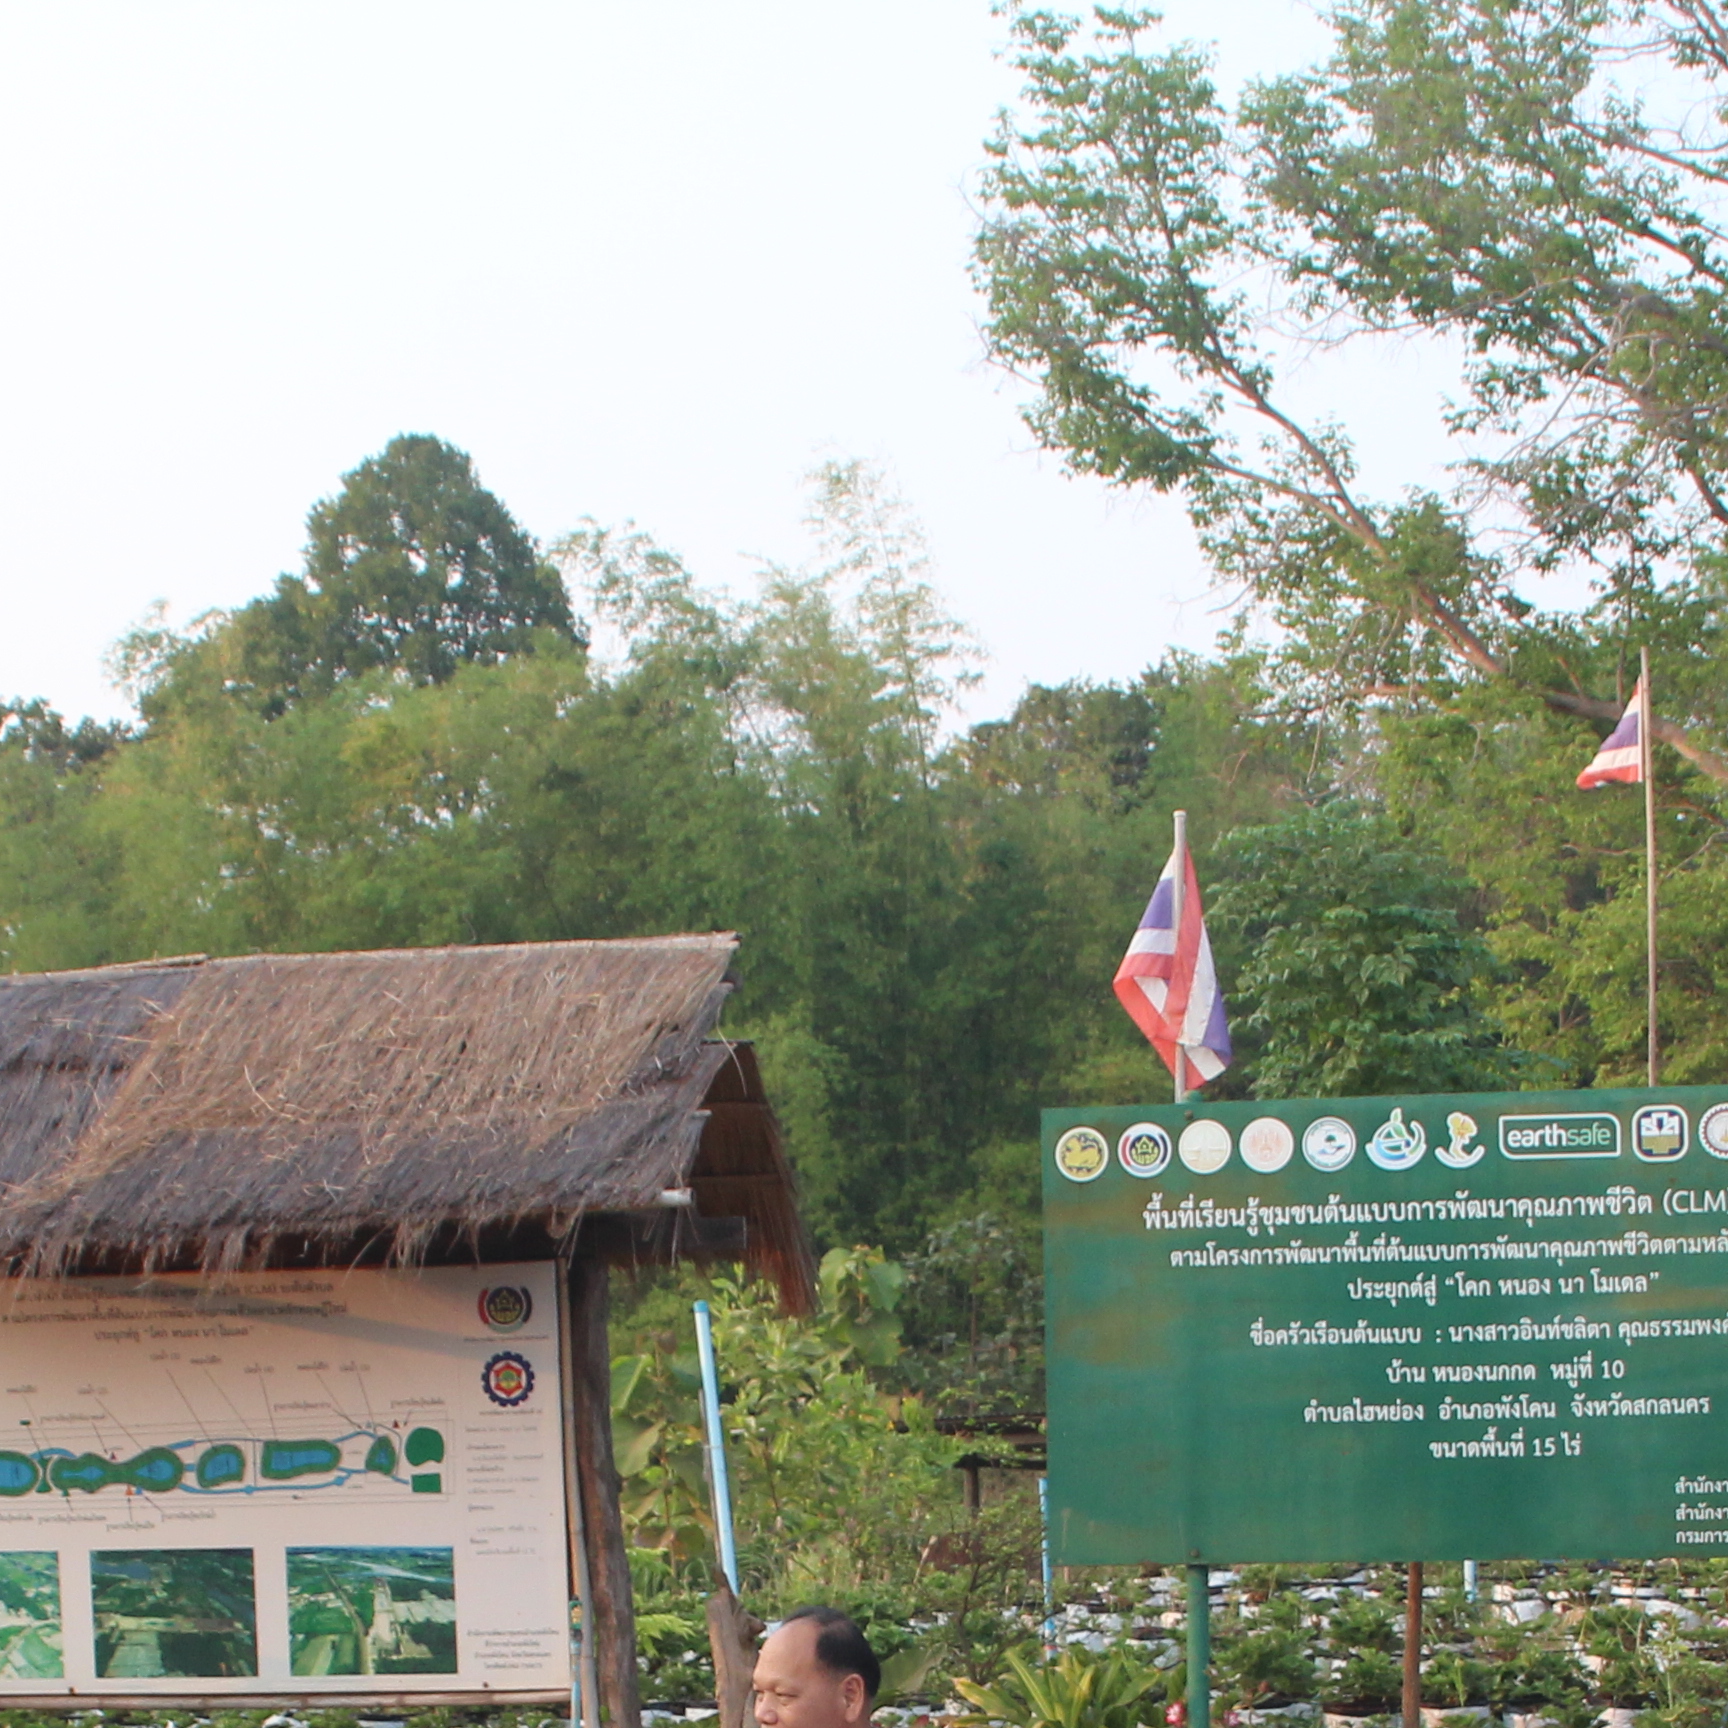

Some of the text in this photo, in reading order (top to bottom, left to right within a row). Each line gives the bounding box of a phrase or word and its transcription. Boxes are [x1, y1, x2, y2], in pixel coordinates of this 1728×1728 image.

[1507, 1121, 1612, 1150] earthsafe
[1142, 1184, 1653, 1237] พื้นที่เรียนรู้ชุมชนต้นแบบการพัฒนาคุณภาพชีวิต
[1347, 1273, 1437, 1307] ประยุกต์สู่
[1498, 1277, 1552, 1297] หนอง
[1558, 1275, 1586, 1294] นา
[1249, 1316, 1423, 1347] ชื่อครัวเรือนต้นแบบ
[1385, 1350, 1626, 1389] บ้าน หนองนกกด หมู่ที่ 10
[1303, 1391, 1711, 1424] ตำบลไฮหย่อง อำเภอพังโคน จังหวัดสกลนคร
[1428, 1426, 1583, 1459] ขนาดพื้นที่ 15 ไร่
